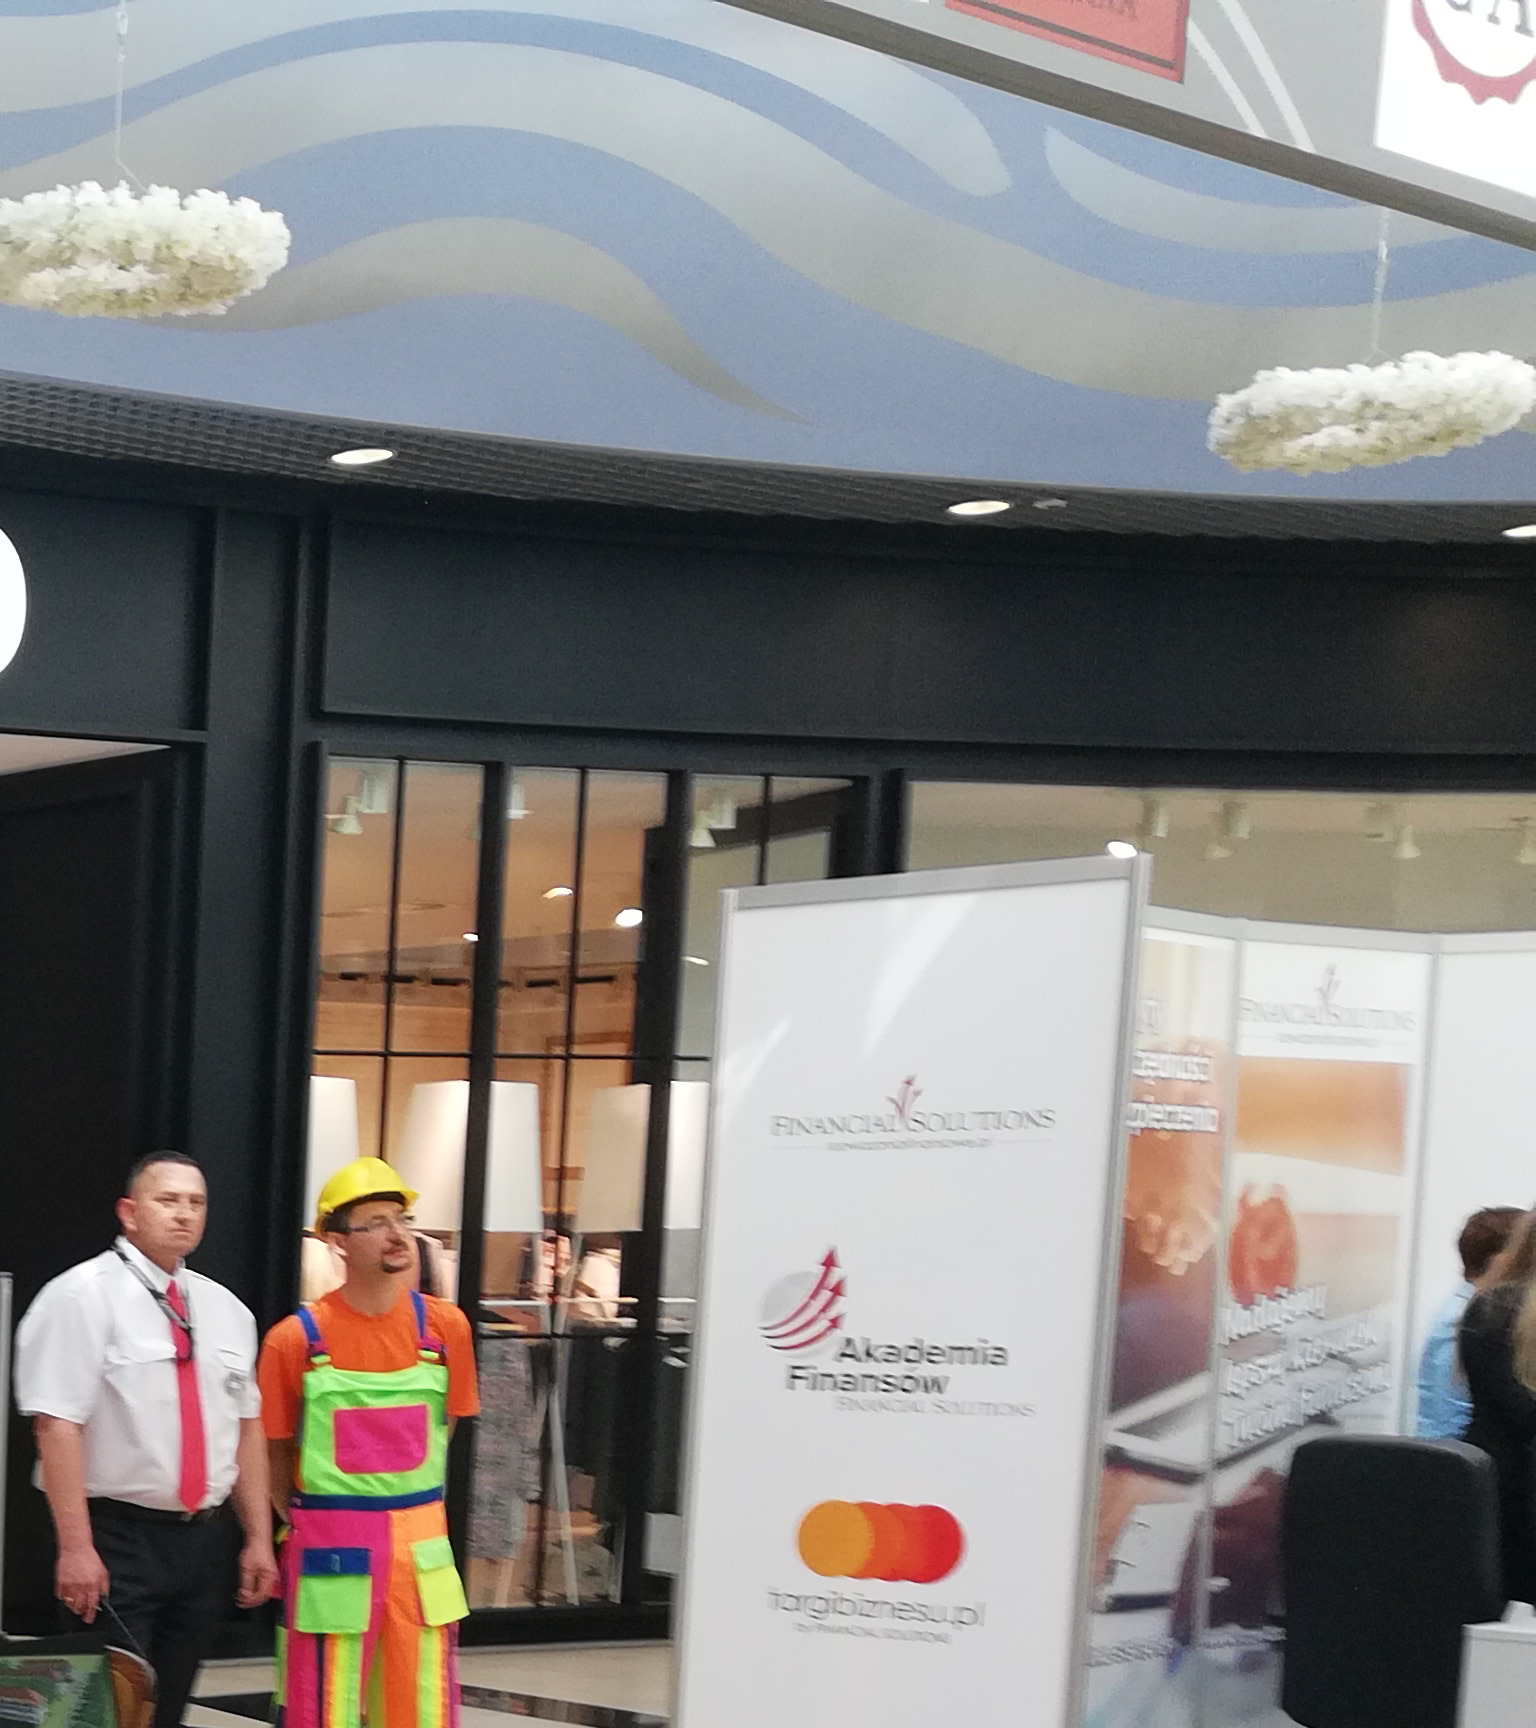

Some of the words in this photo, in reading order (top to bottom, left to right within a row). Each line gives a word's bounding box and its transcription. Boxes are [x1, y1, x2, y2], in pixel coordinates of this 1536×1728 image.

[771, 1113, 902, 1136] FINANCIAL
[905, 1109, 1056, 1134] SOLUTIONS
[833, 1336, 1009, 1366] Akademia
[785, 1364, 950, 1394] Finansów
[766, 1586, 987, 1632] targibiznesu.pl
